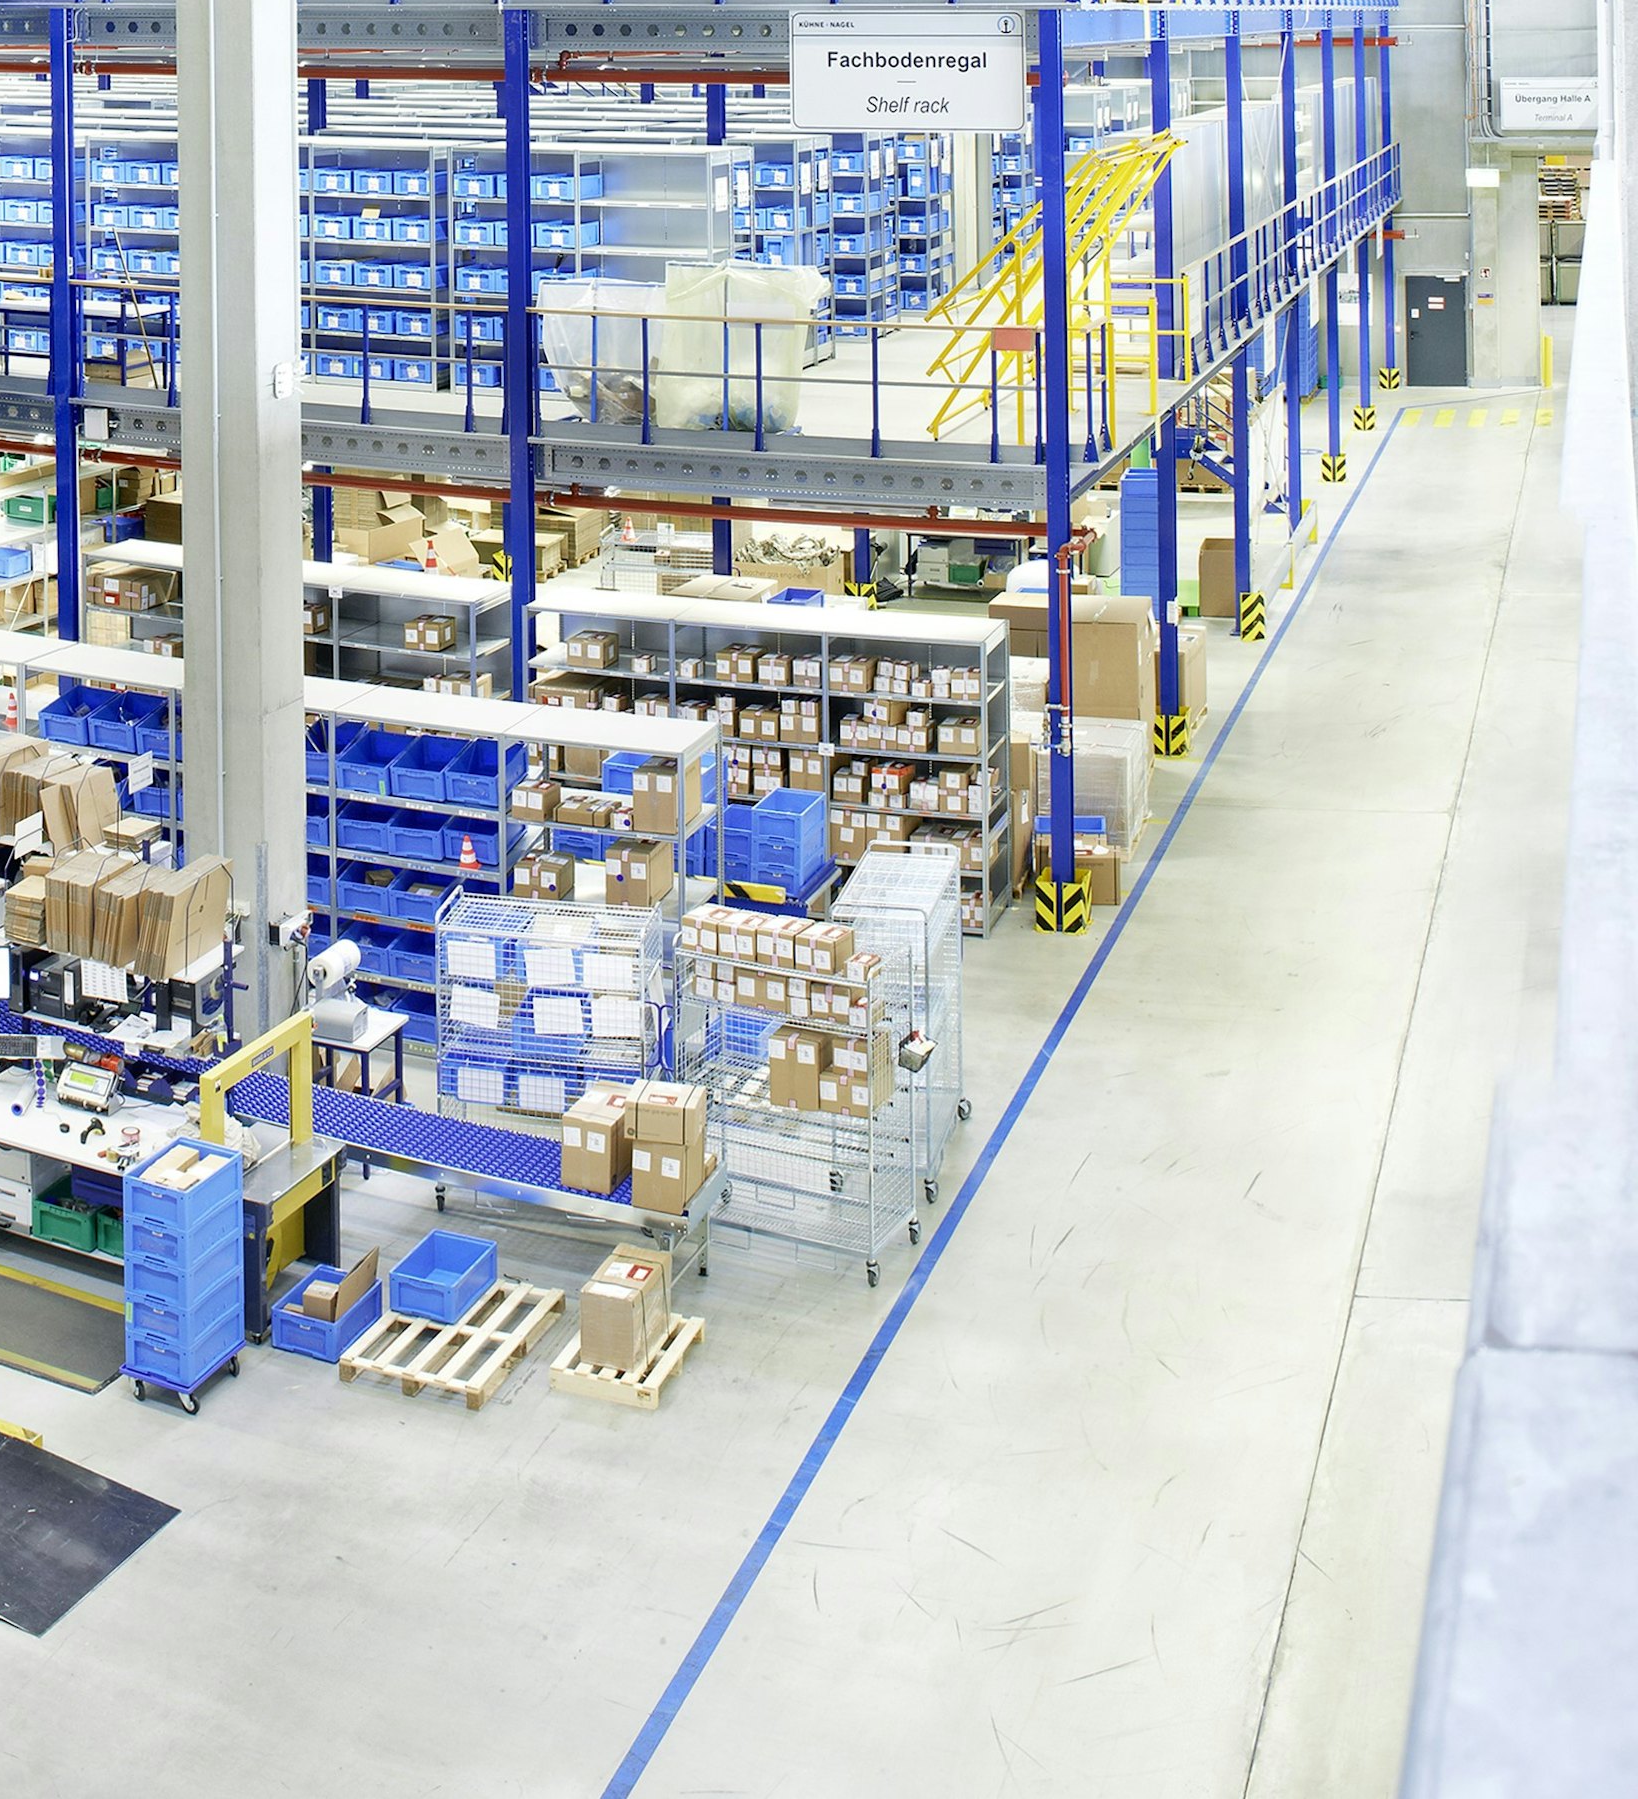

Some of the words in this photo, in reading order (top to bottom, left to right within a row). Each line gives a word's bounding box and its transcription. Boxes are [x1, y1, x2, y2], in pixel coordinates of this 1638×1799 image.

[828, 51, 987, 72] Fachbodenregal
[866, 96, 910, 114] Shelf
[914, 96, 950, 114] rack
[1515, 94, 1558, 104] Übergang
[1560, 94, 1582, 102] Halle
[1535, 114, 1564, 122] Terminal
